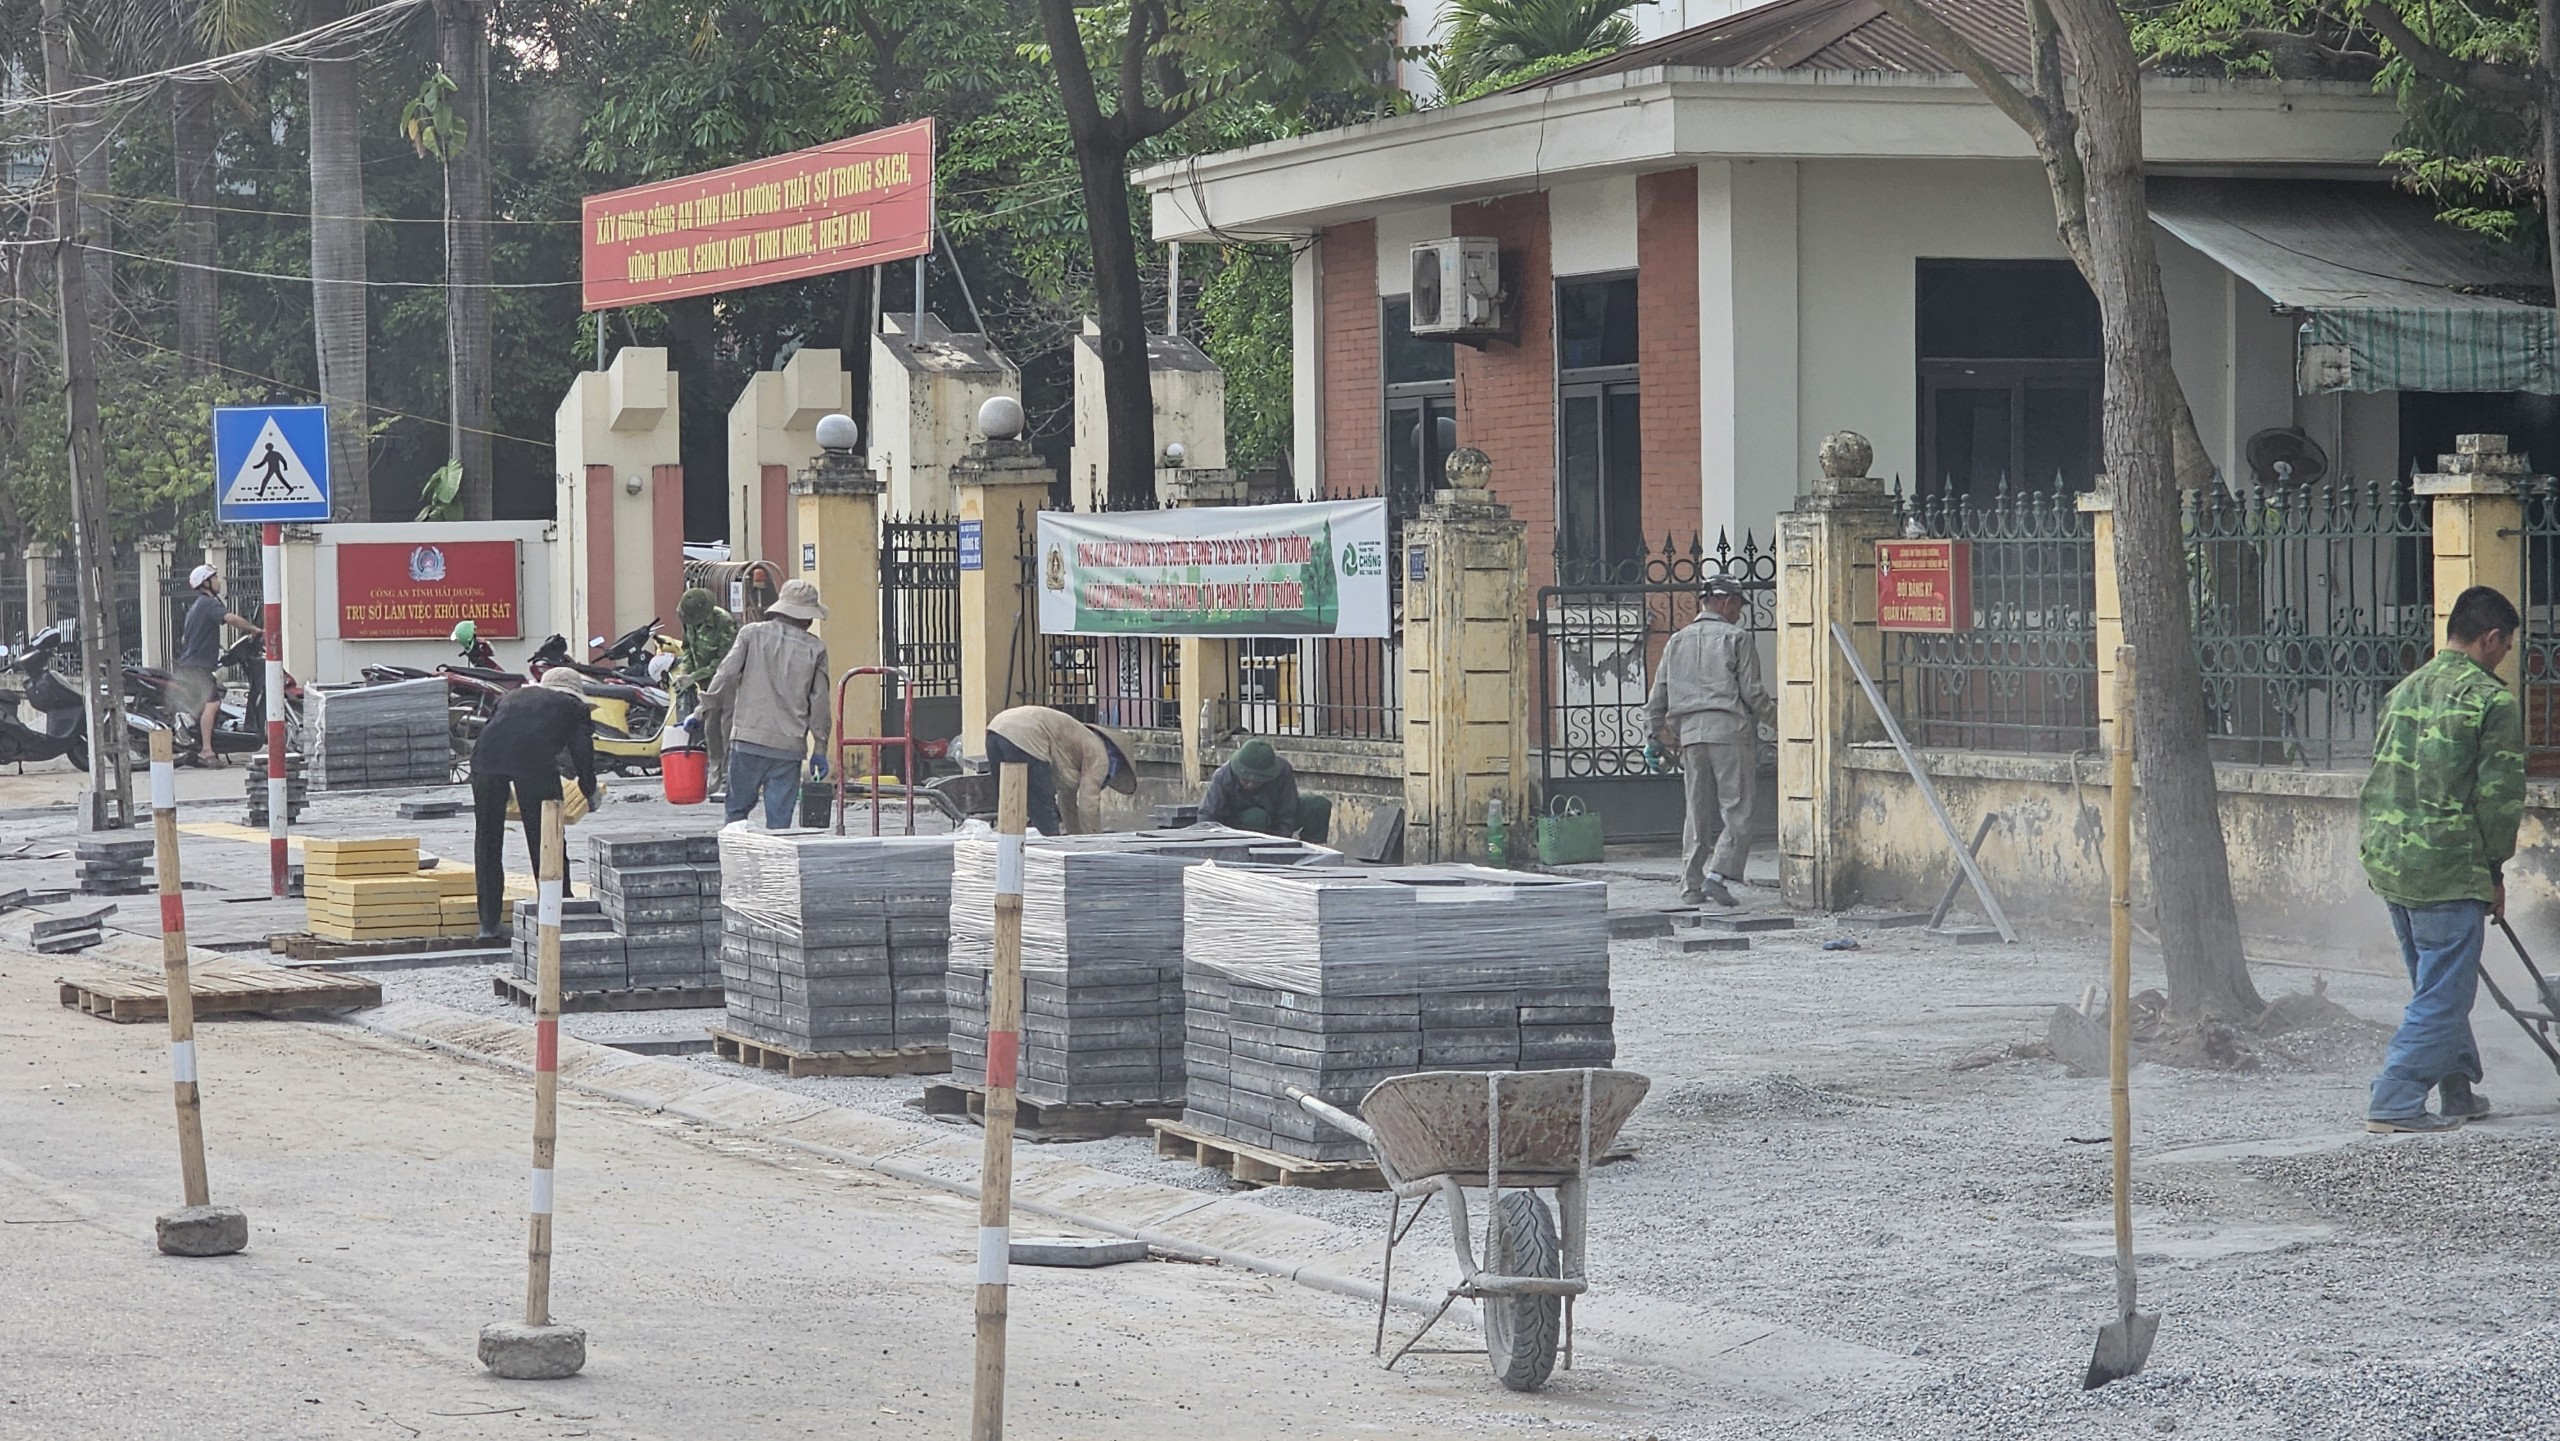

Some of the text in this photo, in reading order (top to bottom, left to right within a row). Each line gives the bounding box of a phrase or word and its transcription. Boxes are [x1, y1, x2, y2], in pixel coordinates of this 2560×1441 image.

[596, 151, 912, 246] XÂY DỰNG CÔNG AN TỈNH HẢI DƯƠNG THẬT SỰ TRONG SẠCH,
[628, 249, 655, 283] VỮNG
[657, 247, 692, 284] MẠNH,
[694, 237, 726, 272] CHÍNH
[754, 231, 780, 260] TINH
[783, 217, 817, 260] NHUỆ,
[819, 211, 847, 255] HIỆN
[850, 210, 871, 249] ĐẠI
[1212, 535, 1229, 565] TÁC
[1260, 532, 1277, 565] MÔI
[1277, 530, 1311, 564] TRƯỜNG
[345, 597, 511, 625] TRỤ SỞ LÀM VIỆC KHỐI CẢNH SÁT
[370, 587, 395, 598] CÔNG
[398, 589, 409, 597] AN
[1202, 578, 1215, 617] TỘI
[1216, 583, 1240, 617] PHẠM
[1253, 577, 1269, 610] MÔI
[1271, 576, 1303, 610] TRƯỜNG
